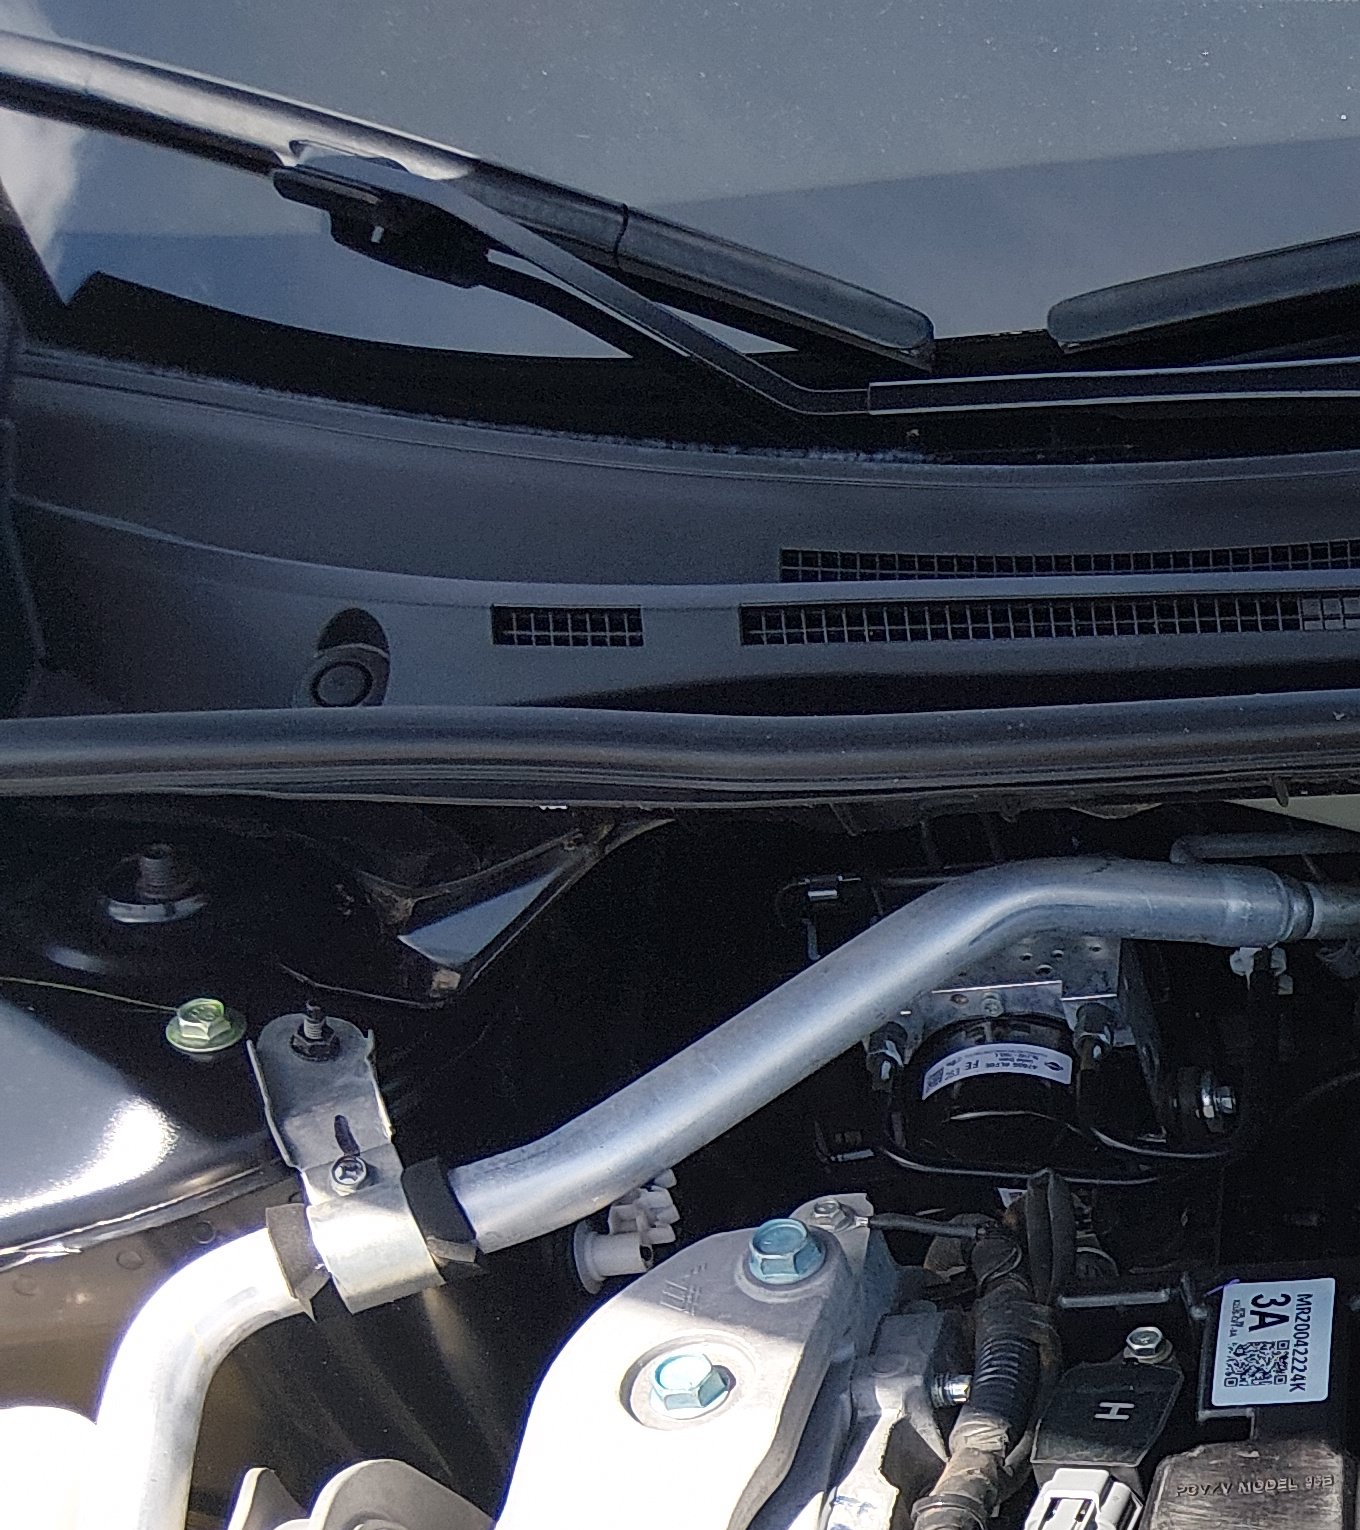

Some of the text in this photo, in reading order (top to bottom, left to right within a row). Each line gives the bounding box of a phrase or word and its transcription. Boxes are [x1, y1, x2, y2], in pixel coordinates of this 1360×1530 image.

[1247, 1292, 1291, 1332] 3A
[1288, 1293, 1313, 1392] MR20042224K
[1094, 1402, 1135, 1420] H
[1238, 1478, 1298, 1495] MODEL
